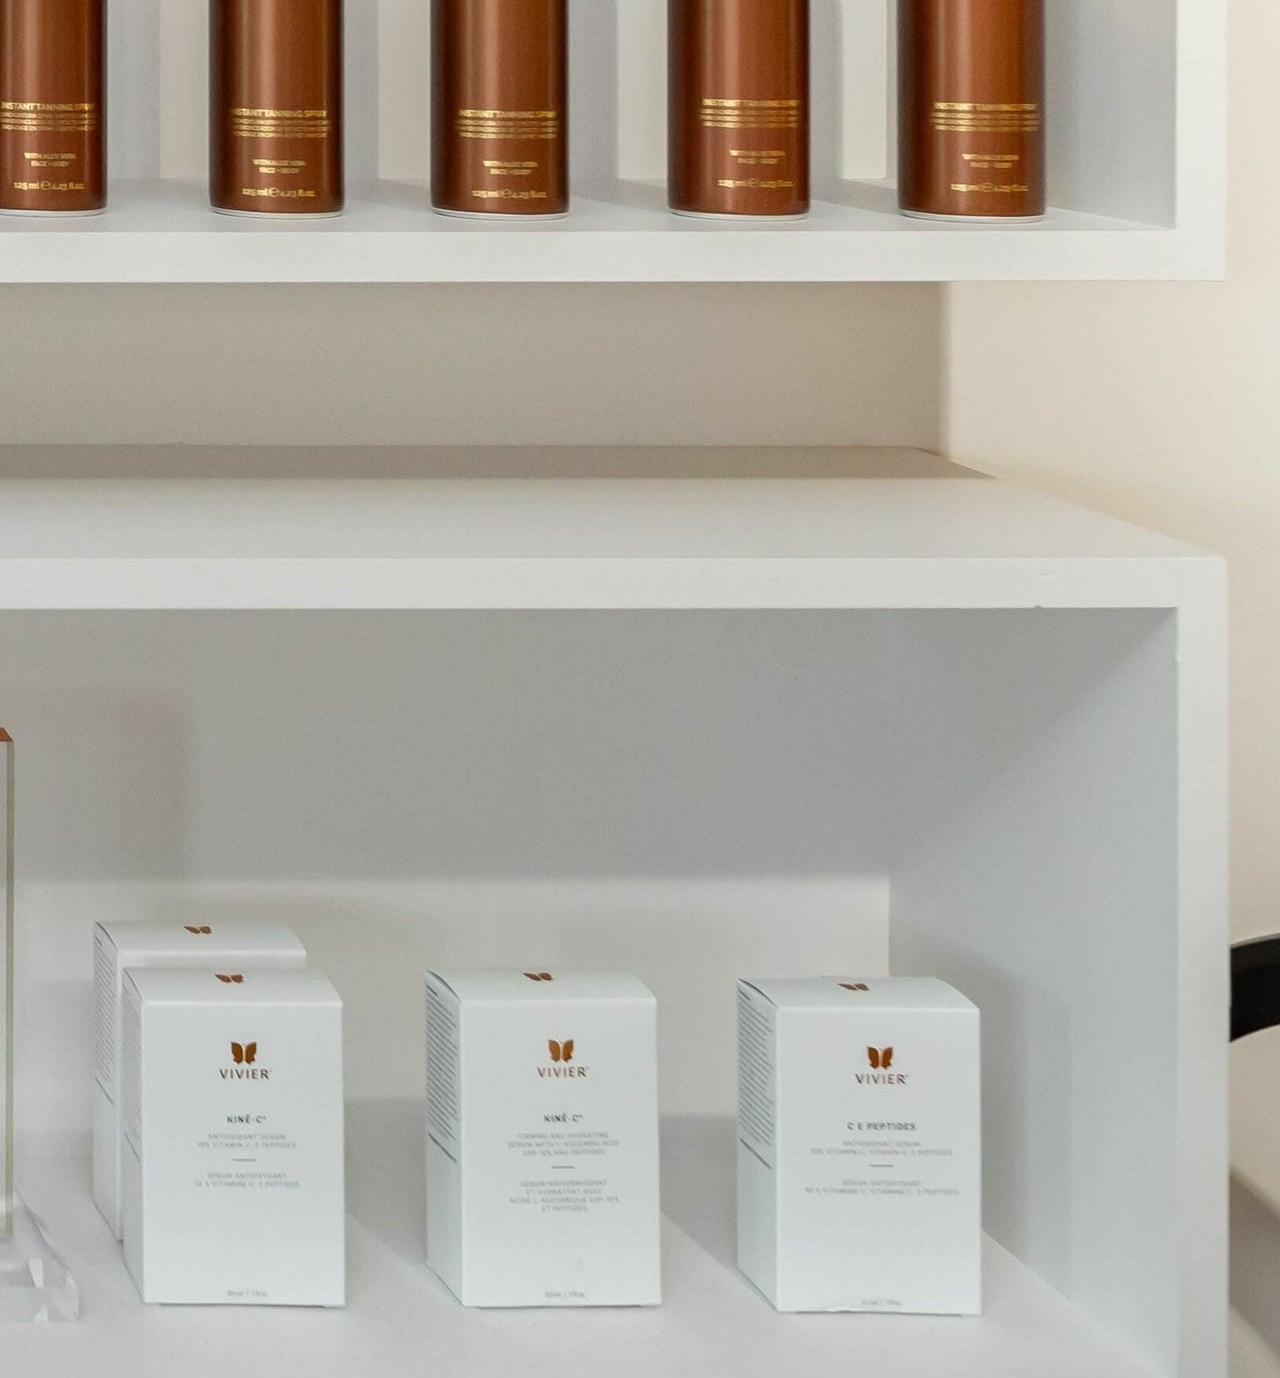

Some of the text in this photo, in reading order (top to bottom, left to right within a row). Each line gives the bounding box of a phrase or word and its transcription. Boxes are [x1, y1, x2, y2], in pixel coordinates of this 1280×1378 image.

[219, 1068, 269, 1080] VIVIER
[537, 1067, 587, 1078] VIVIER
[855, 1073, 907, 1085] VIVIER
[866, 1122, 917, 1131] PEPTIDES
